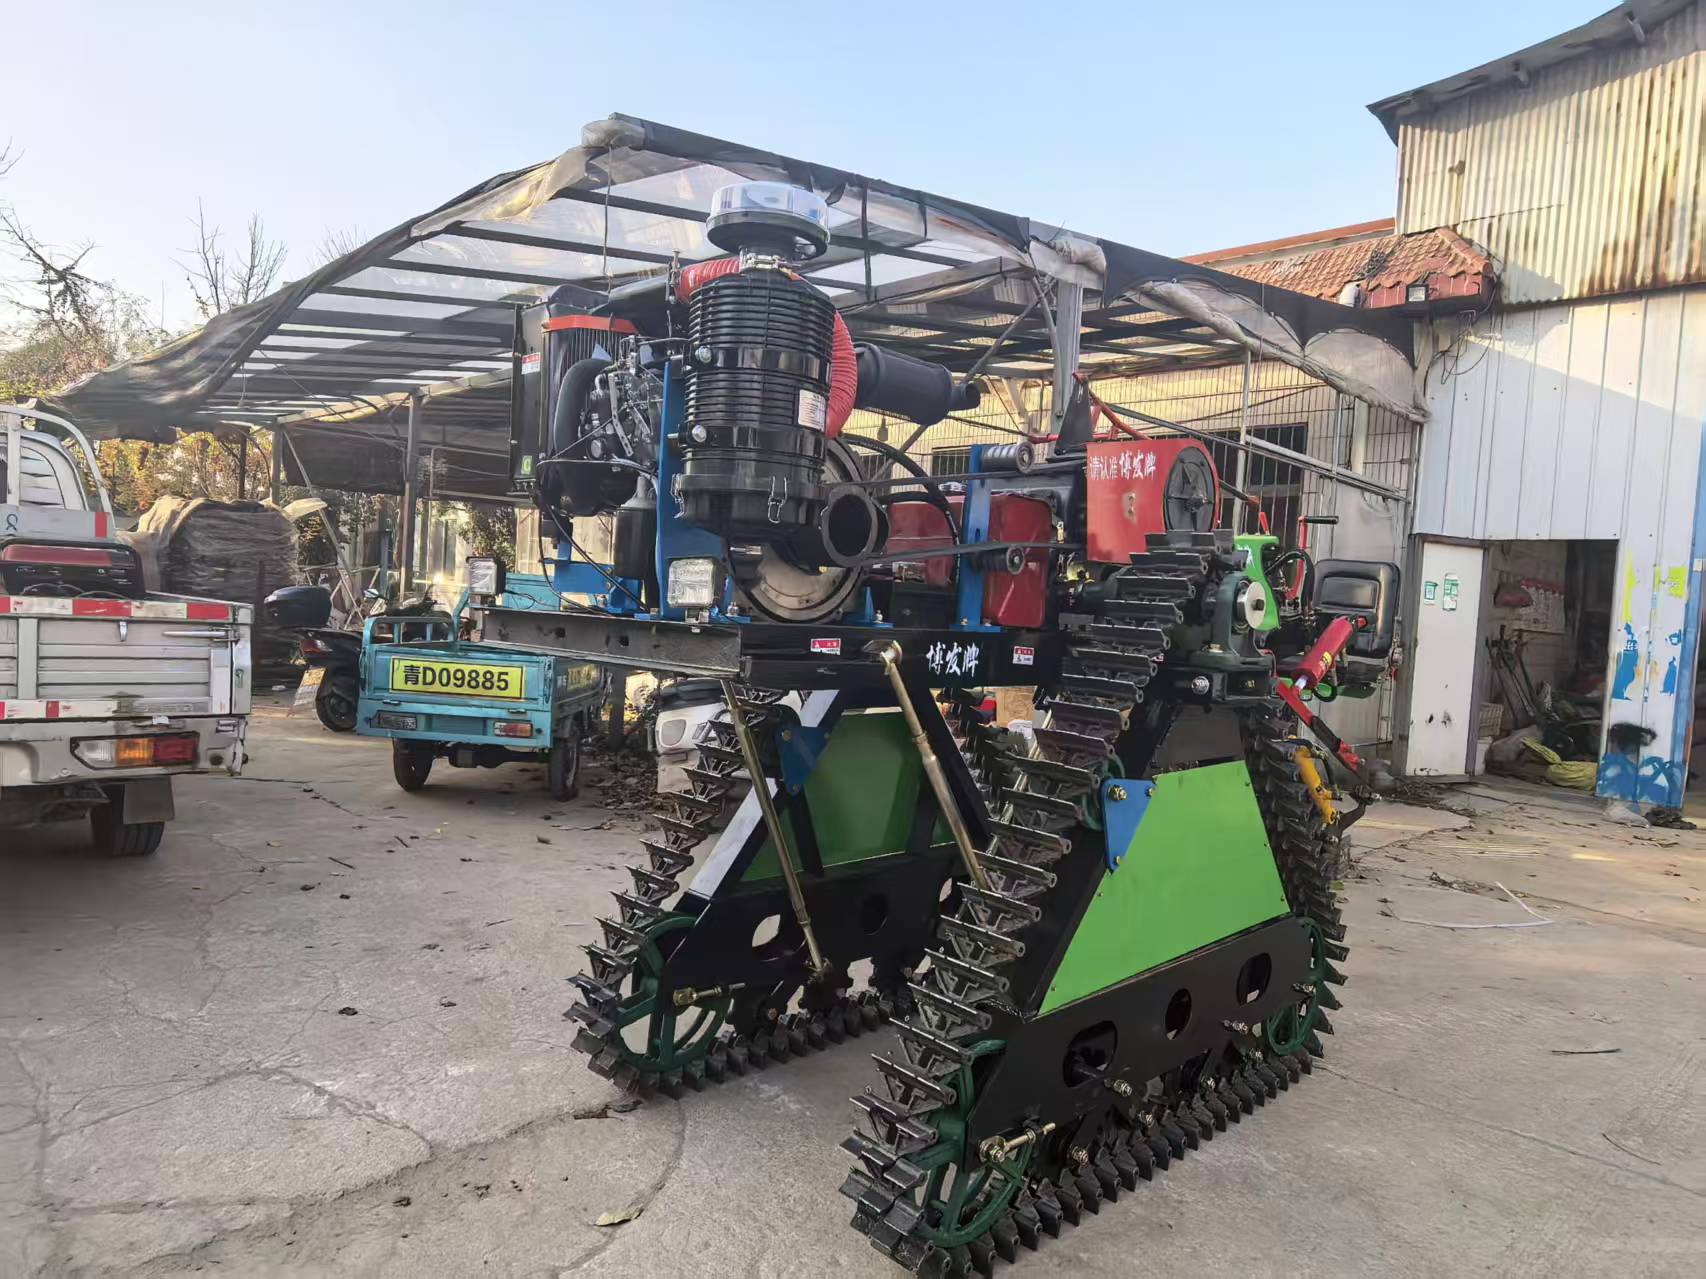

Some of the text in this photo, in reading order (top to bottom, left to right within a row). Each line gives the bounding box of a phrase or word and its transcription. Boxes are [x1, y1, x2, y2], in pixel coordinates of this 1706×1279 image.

[926, 641, 980, 677] 博发牌
[403, 664, 509, 691] 青D09885
